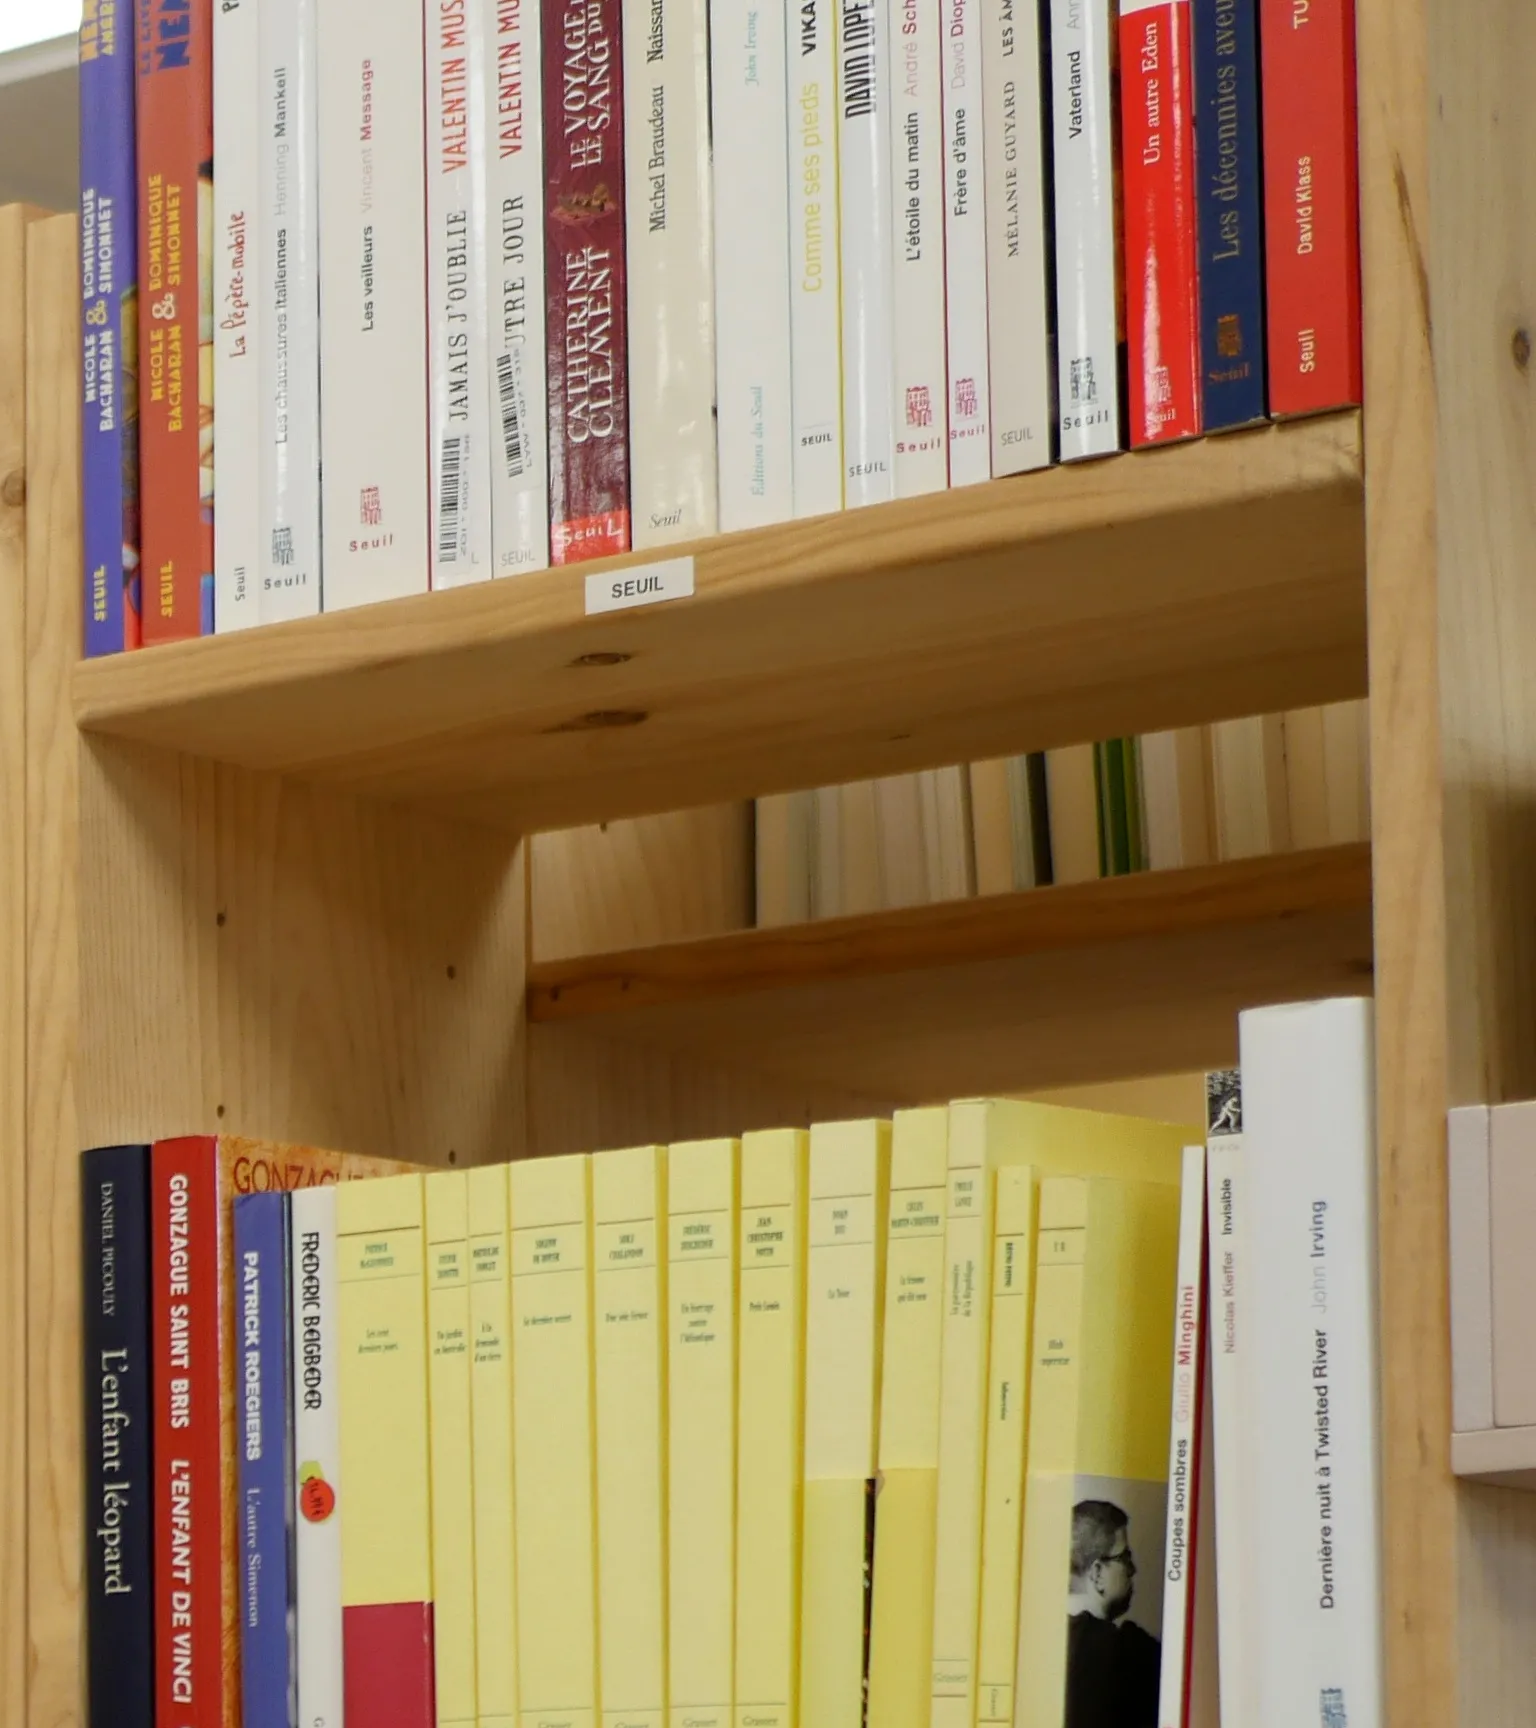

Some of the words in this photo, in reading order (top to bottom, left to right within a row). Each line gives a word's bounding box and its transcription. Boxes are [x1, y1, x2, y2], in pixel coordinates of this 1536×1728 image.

[563, 8, 588, 138] VOYAGE
[1141, 22, 1159, 73] Eden
[274, 67, 287, 138] Mankell
[360, 58, 374, 141] Message
[441, 57, 468, 175] VALENTIN
[498, 42, 523, 160] VALENTIN
[648, 85, 665, 172] Braudeau
[802, 82, 823, 147] pieds
[1003, 82, 1017, 161] GUYARD
[1067, 50, 1083, 140] Vaterland
[1147, 78, 1160, 127] autre
[904, 111, 919, 162] matin
[952, 108, 966, 163] d'âme
[1143, 136, 1161, 165] Un
[1211, 64, 1239, 202] décennies
[362, 147, 373, 215] Vincent
[649, 174, 666, 233] Michel
[804, 154, 820, 195] ses
[905, 166, 919, 192] du
[954, 166, 967, 217] Frère
[1296, 156, 1311, 201] Klass
[83, 188, 95, 299] DOMINIQUE
[98, 197, 113, 294] SIMONNET
[502, 195, 524, 266] JOUR
[906, 196, 921, 262] L'étoile
[1005, 167, 1018, 258] MÉLANIE
[1213, 211, 1241, 262] Les
[1298, 204, 1313, 255] David
[274, 228, 288, 308] italiennes
[361, 225, 373, 297] veilleurs
[447, 210, 468, 324] J'OUBLIE
[802, 204, 822, 293] Comme
[229, 336, 247, 358] La
[362, 300, 374, 332] Les
[566, 244, 590, 443] CATHERINE
[1300, 328, 1315, 372] Seuil
[85, 334, 97, 403] NICOLE
[99, 328, 115, 432] BACHARAN
[449, 332, 469, 423] JAMAIS
[349, 534, 394, 552] Seuil
[94, 564, 108, 622] SEUIL
[611, 575, 665, 599] SEUIL
[169, 1173, 190, 1296] GONZAGUE
[1309, 1200, 1327, 1258] Irving
[244, 1251, 260, 1348] PATRICK
[1177, 1285, 1195, 1366] Minghini
[170, 1304, 190, 1369] SAINT
[1313, 1328, 1328, 1379] River
[101, 1349, 130, 1472] L'enfant
[171, 1379, 190, 1429] BRIS
[244, 1352, 261, 1461] ROEGIERS
[1314, 1384, 1331, 1460] Twisted
[1173, 1438, 1188, 1510] sombres
[1317, 1465, 1331, 1478] à
[1319, 1482, 1332, 1521] nuit
[97, 1482, 132, 1596] léopard
[171, 1459, 192, 1585] L'ENFANT
[1168, 1513, 1184, 1582] Coupes
[1319, 1527, 1335, 1610] Dernière
[172, 1591, 192, 1627] DE
[173, 1635, 192, 1704] VINCI
